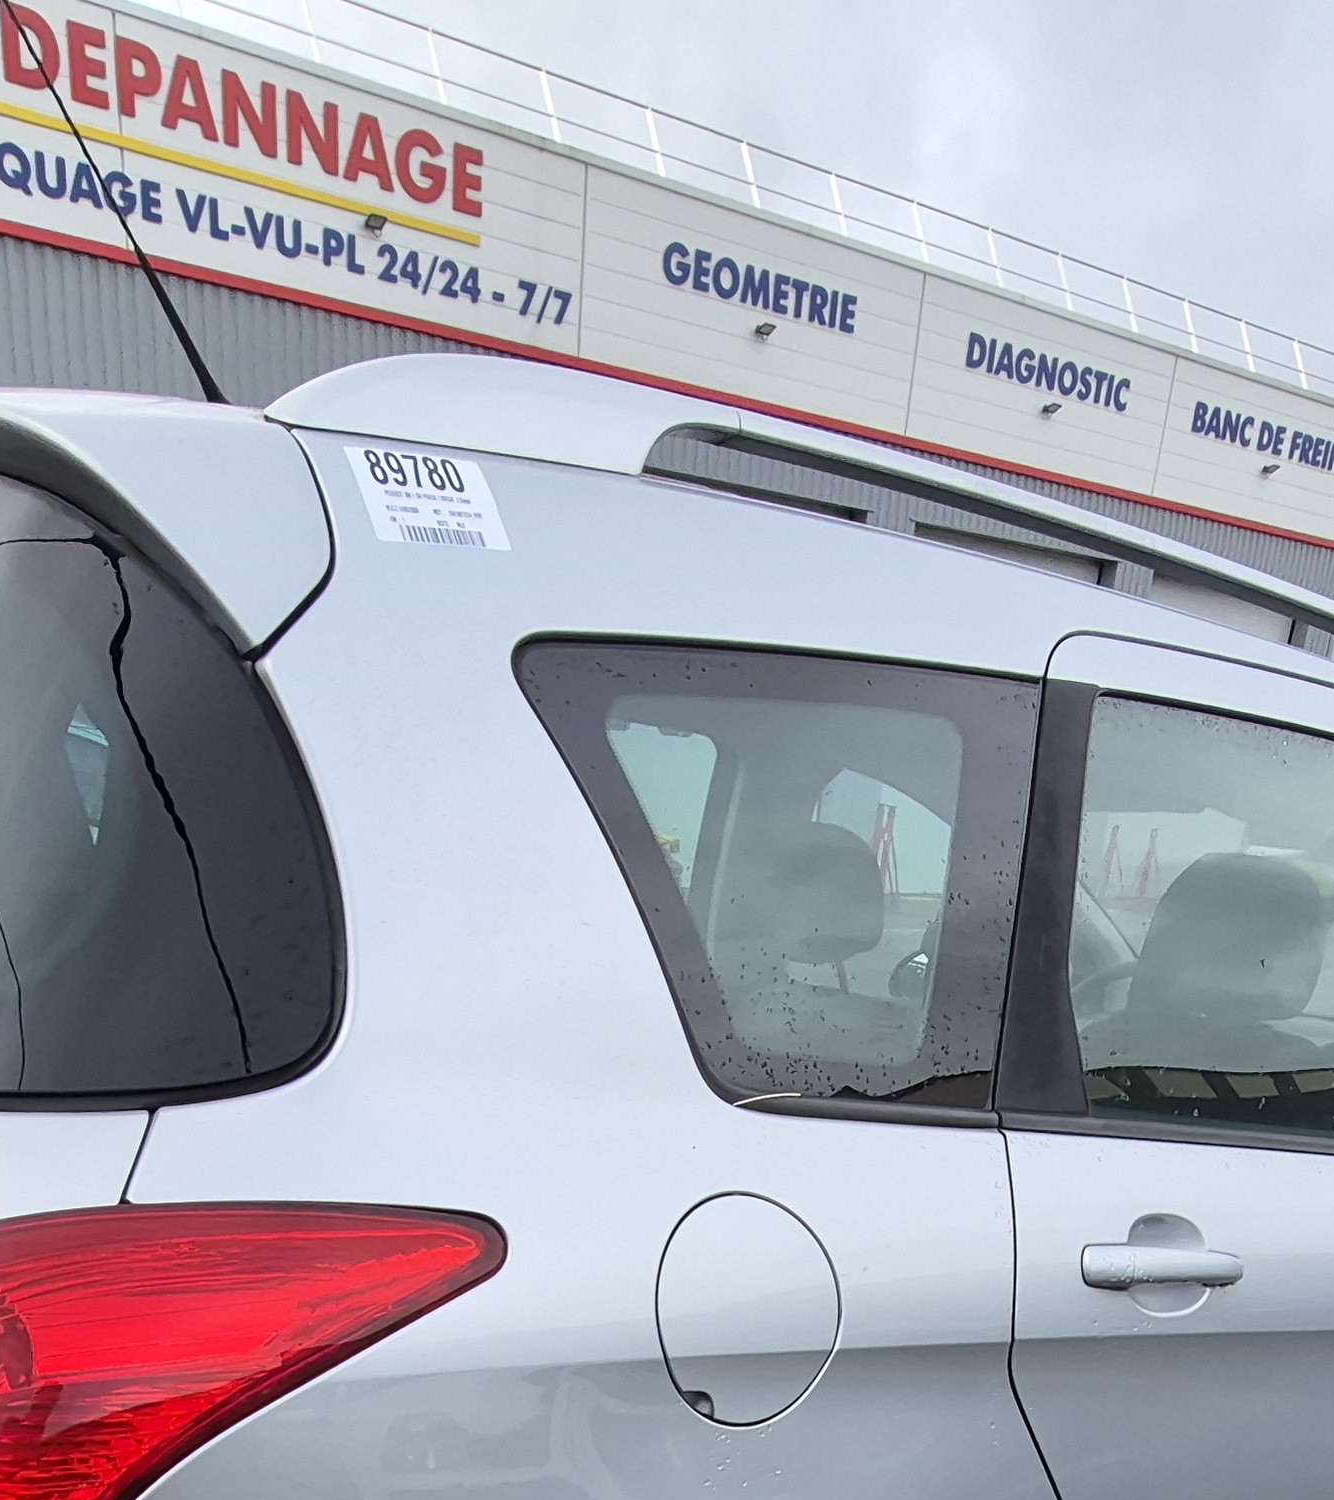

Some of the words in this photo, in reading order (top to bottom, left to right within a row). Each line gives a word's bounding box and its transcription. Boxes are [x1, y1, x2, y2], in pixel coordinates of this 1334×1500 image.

[0, 0, 485, 218] DEPANNAGE
[376, 243, 482, 304] 24/24
[517, 279, 573, 325] 7/7
[662, 241, 858, 334] GEOMETRIE
[965, 332, 1131, 413] DIAGNOSTIC
[1190, 401, 1255, 449] BANC
[1256, 420, 1288, 456] DE
[363, 449, 465, 493] 89780
